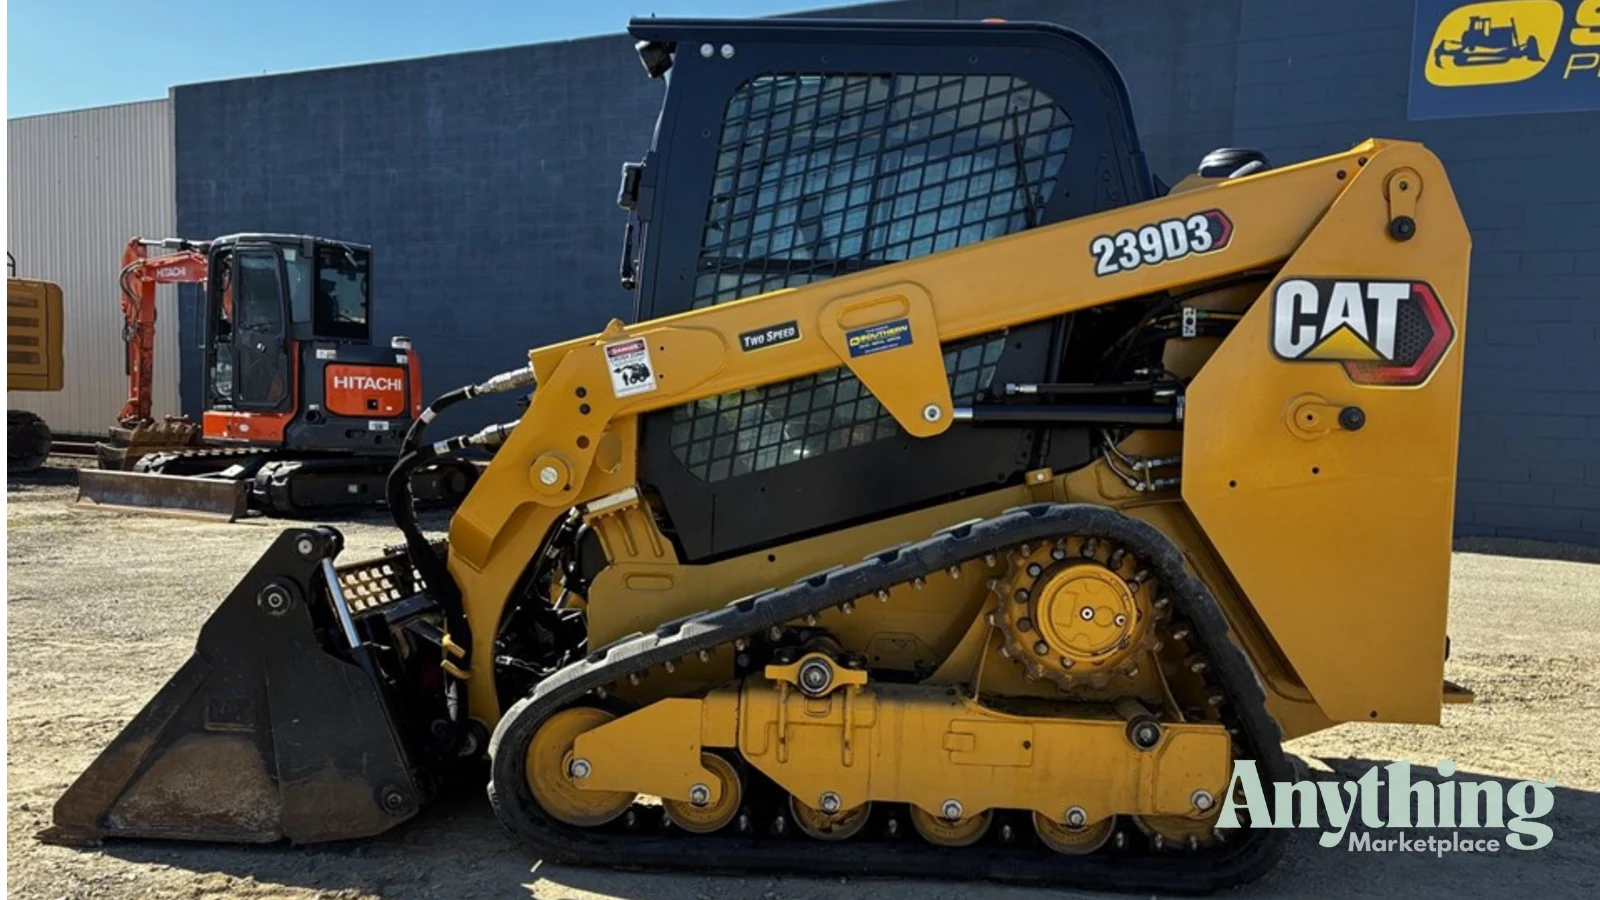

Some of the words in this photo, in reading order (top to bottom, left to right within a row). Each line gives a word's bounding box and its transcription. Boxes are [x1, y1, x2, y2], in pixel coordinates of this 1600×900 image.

[1563, 52, 1600, 79] P
[1091, 214, 1213, 276] 239D3
[156, 266, 186, 278] HITACHI
[1273, 279, 1411, 361] CAT
[333, 375, 403, 391] HITACHI
